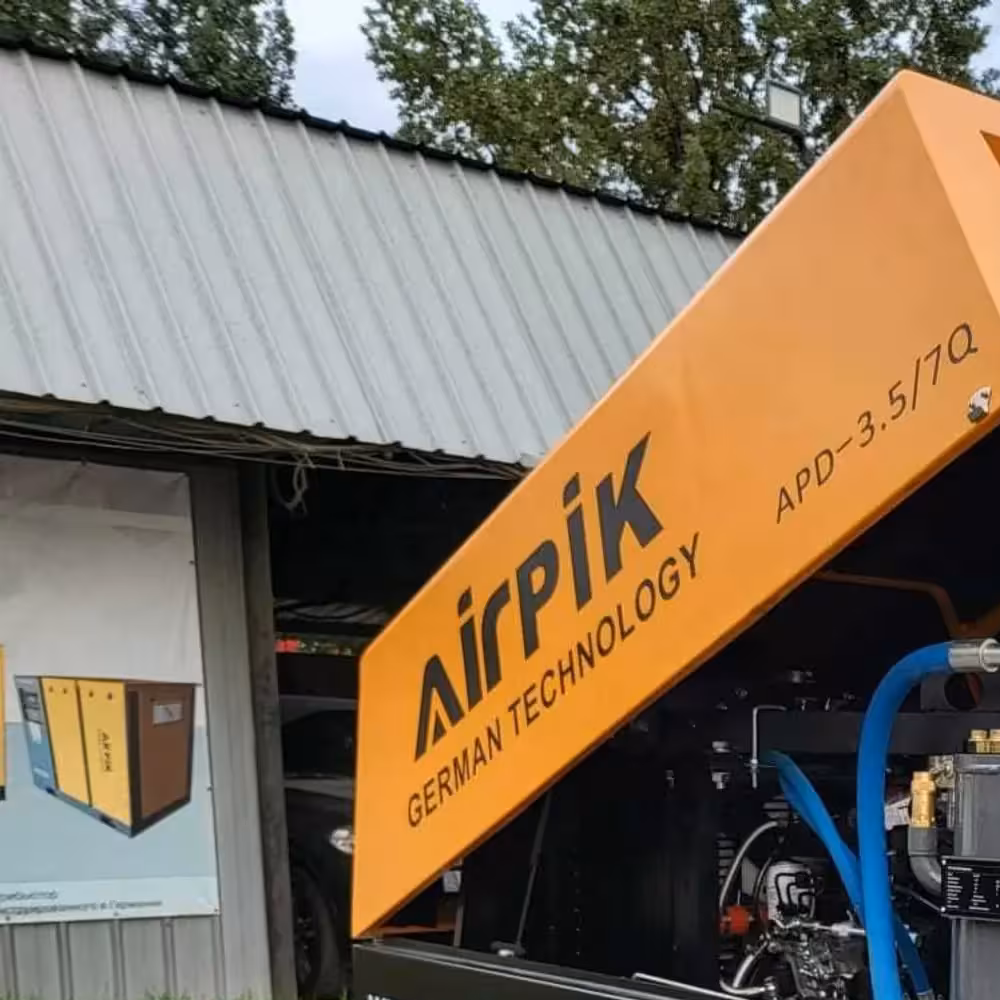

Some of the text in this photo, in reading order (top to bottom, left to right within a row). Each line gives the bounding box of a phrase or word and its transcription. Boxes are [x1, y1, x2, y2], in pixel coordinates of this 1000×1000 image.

[776, 322, 978, 524] APD-3.5/7Q
[407, 531, 700, 828] GERMAN TECHNOLOGY
